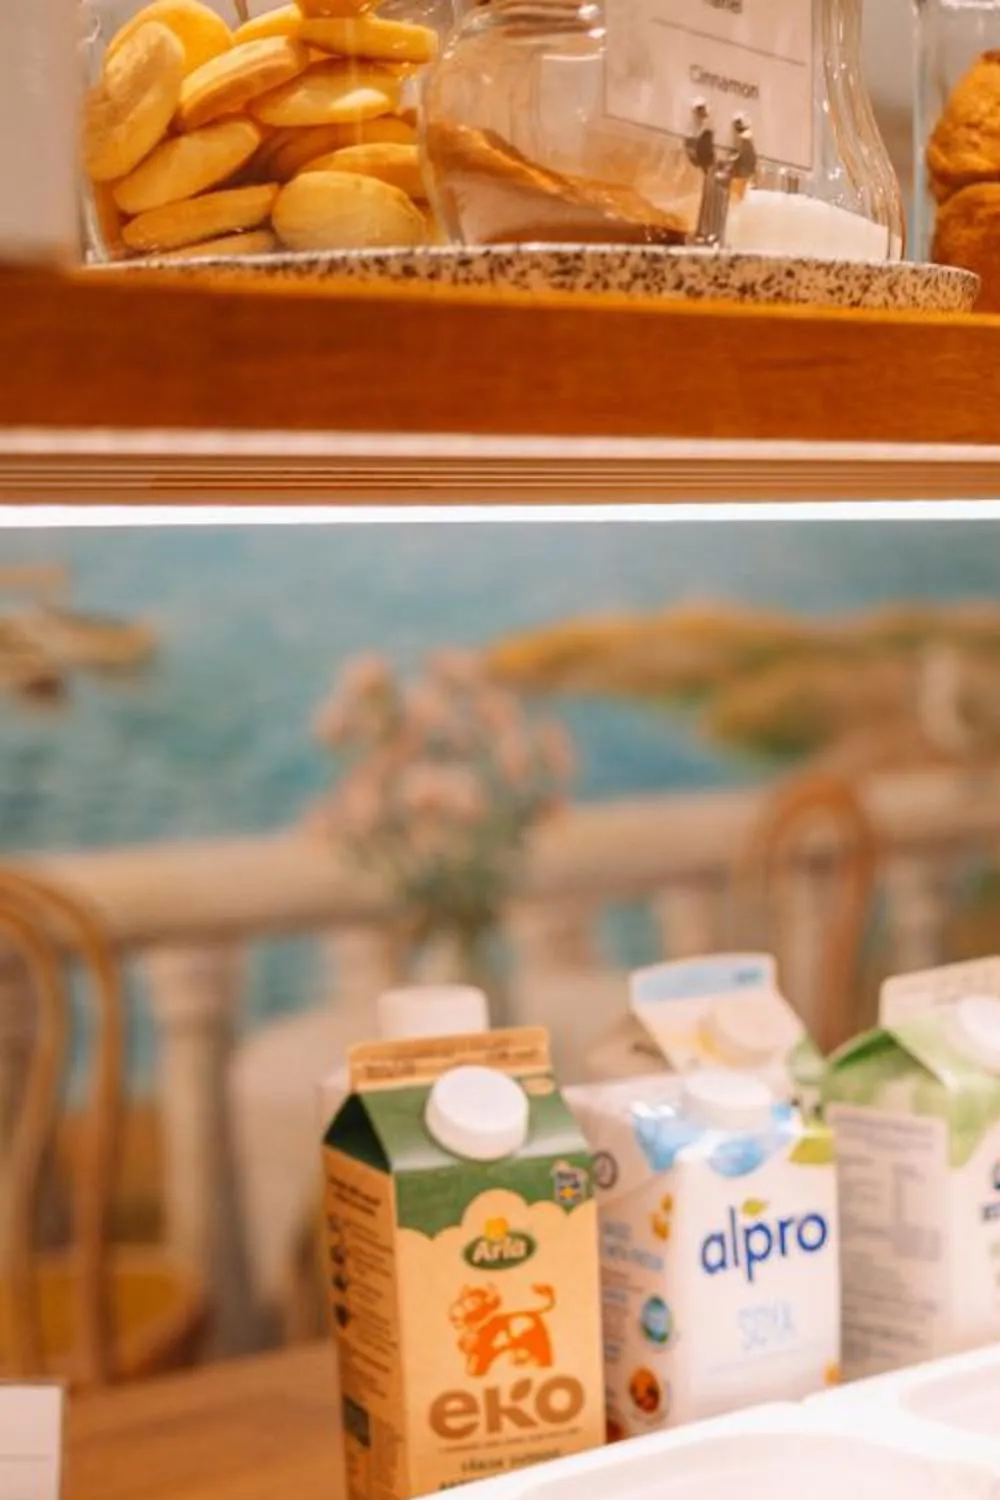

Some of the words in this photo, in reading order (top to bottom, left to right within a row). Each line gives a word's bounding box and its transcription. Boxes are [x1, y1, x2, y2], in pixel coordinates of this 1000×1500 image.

[690, 64, 759, 99] Cinnamon
[471, 1233, 528, 1264] Arla
[701, 1204, 828, 1282] alpro
